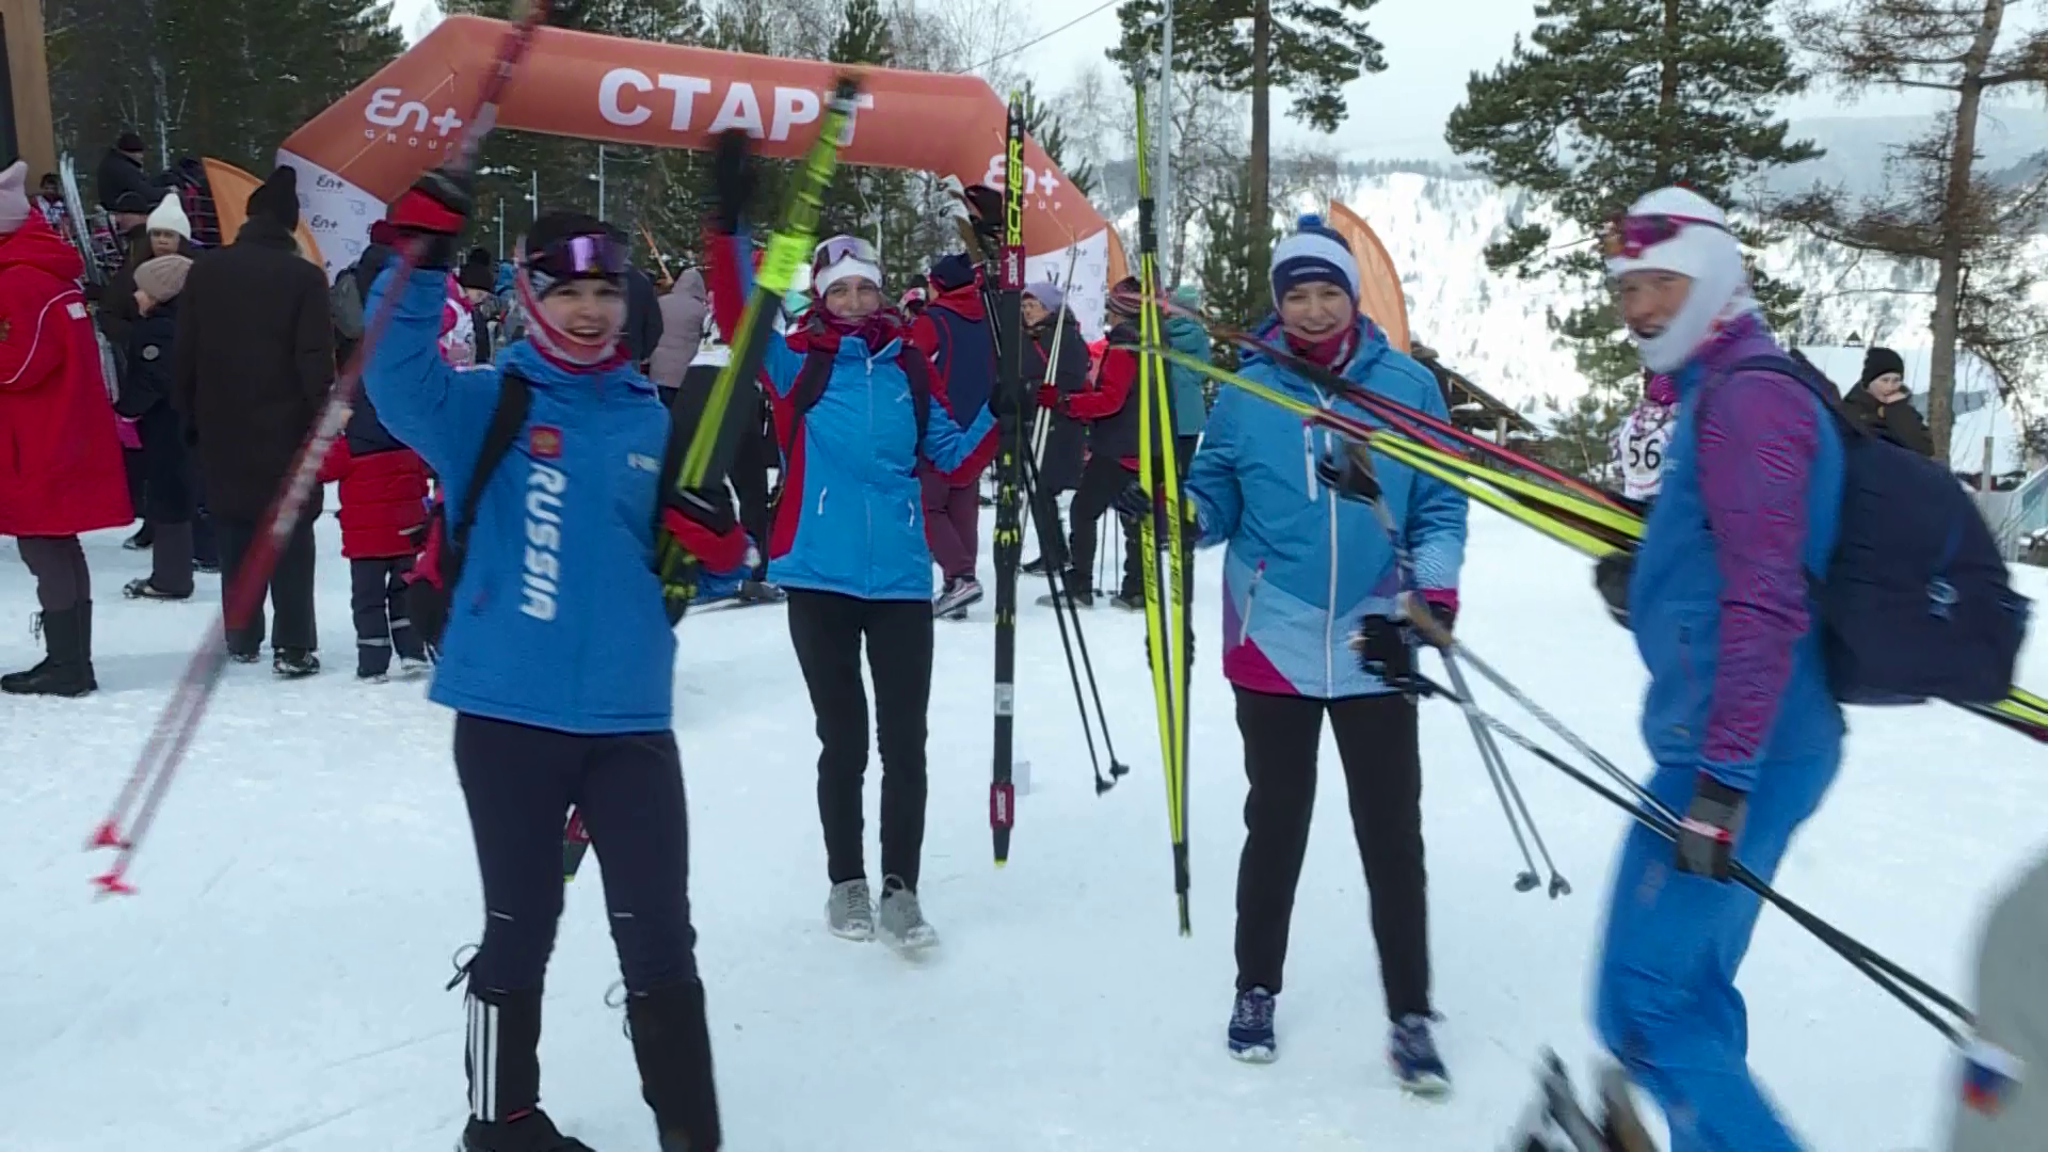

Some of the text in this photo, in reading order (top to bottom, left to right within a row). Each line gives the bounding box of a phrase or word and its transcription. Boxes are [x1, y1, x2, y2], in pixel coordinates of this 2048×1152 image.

[598, 67, 874, 147] СТАРТ
[1008, 138, 1022, 246] SCHER
[1629, 436, 1661, 469] 56
[520, 462, 567, 621] RUSSIA
